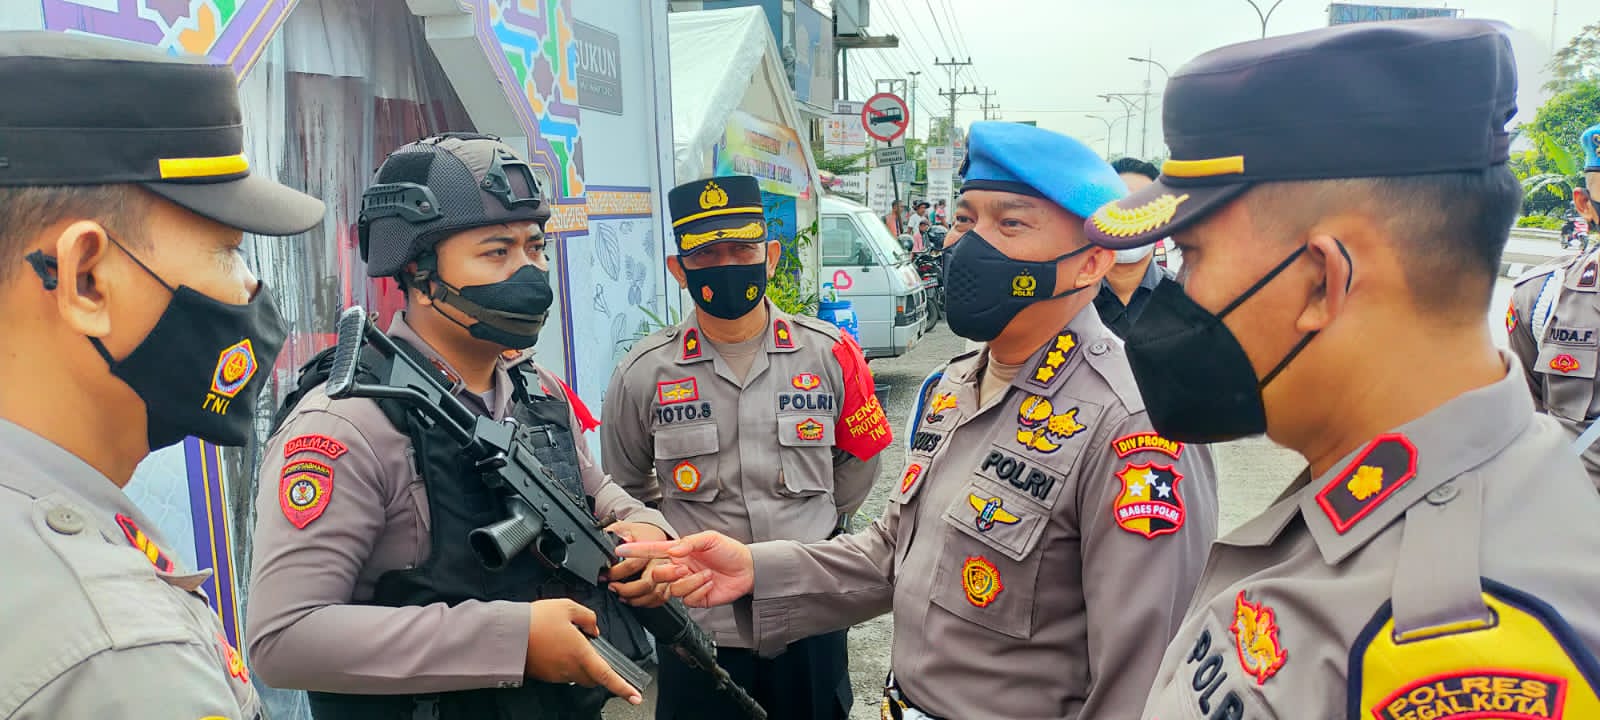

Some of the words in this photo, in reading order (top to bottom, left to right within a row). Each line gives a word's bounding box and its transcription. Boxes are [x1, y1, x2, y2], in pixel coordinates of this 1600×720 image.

[575, 39, 617, 79] SUKUN
[202, 393, 230, 415] TNI
[779, 393, 832, 410] POLRI
[288, 437, 340, 454] DALMAS
[1118, 437, 1137, 452] DIV
[1137, 435, 1178, 454] PROPAM
[981, 450, 1055, 500] POLRI
[1119, 504, 1152, 518] MABES
[1153, 505, 1178, 520] POLRI
[1387, 676, 1547, 719] POLRES
[1471, 693, 1548, 717] KOTA
